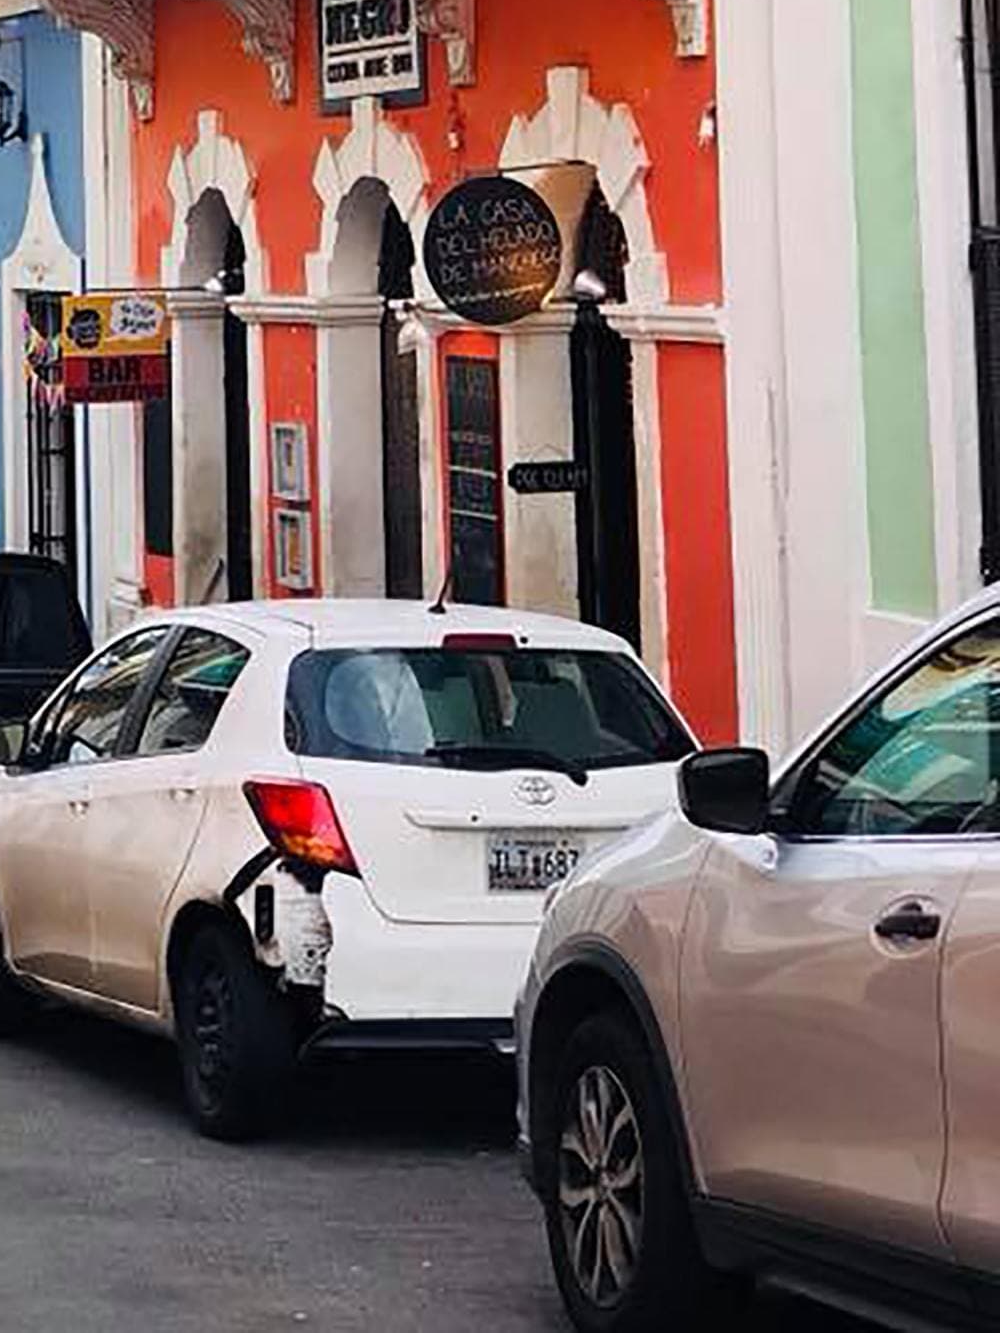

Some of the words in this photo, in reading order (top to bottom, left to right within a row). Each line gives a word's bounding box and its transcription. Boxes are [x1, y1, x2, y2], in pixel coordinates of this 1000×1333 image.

[438, 204, 470, 228] LA
[480, 198, 538, 225] CASA
[88, 357, 142, 383] BAR
